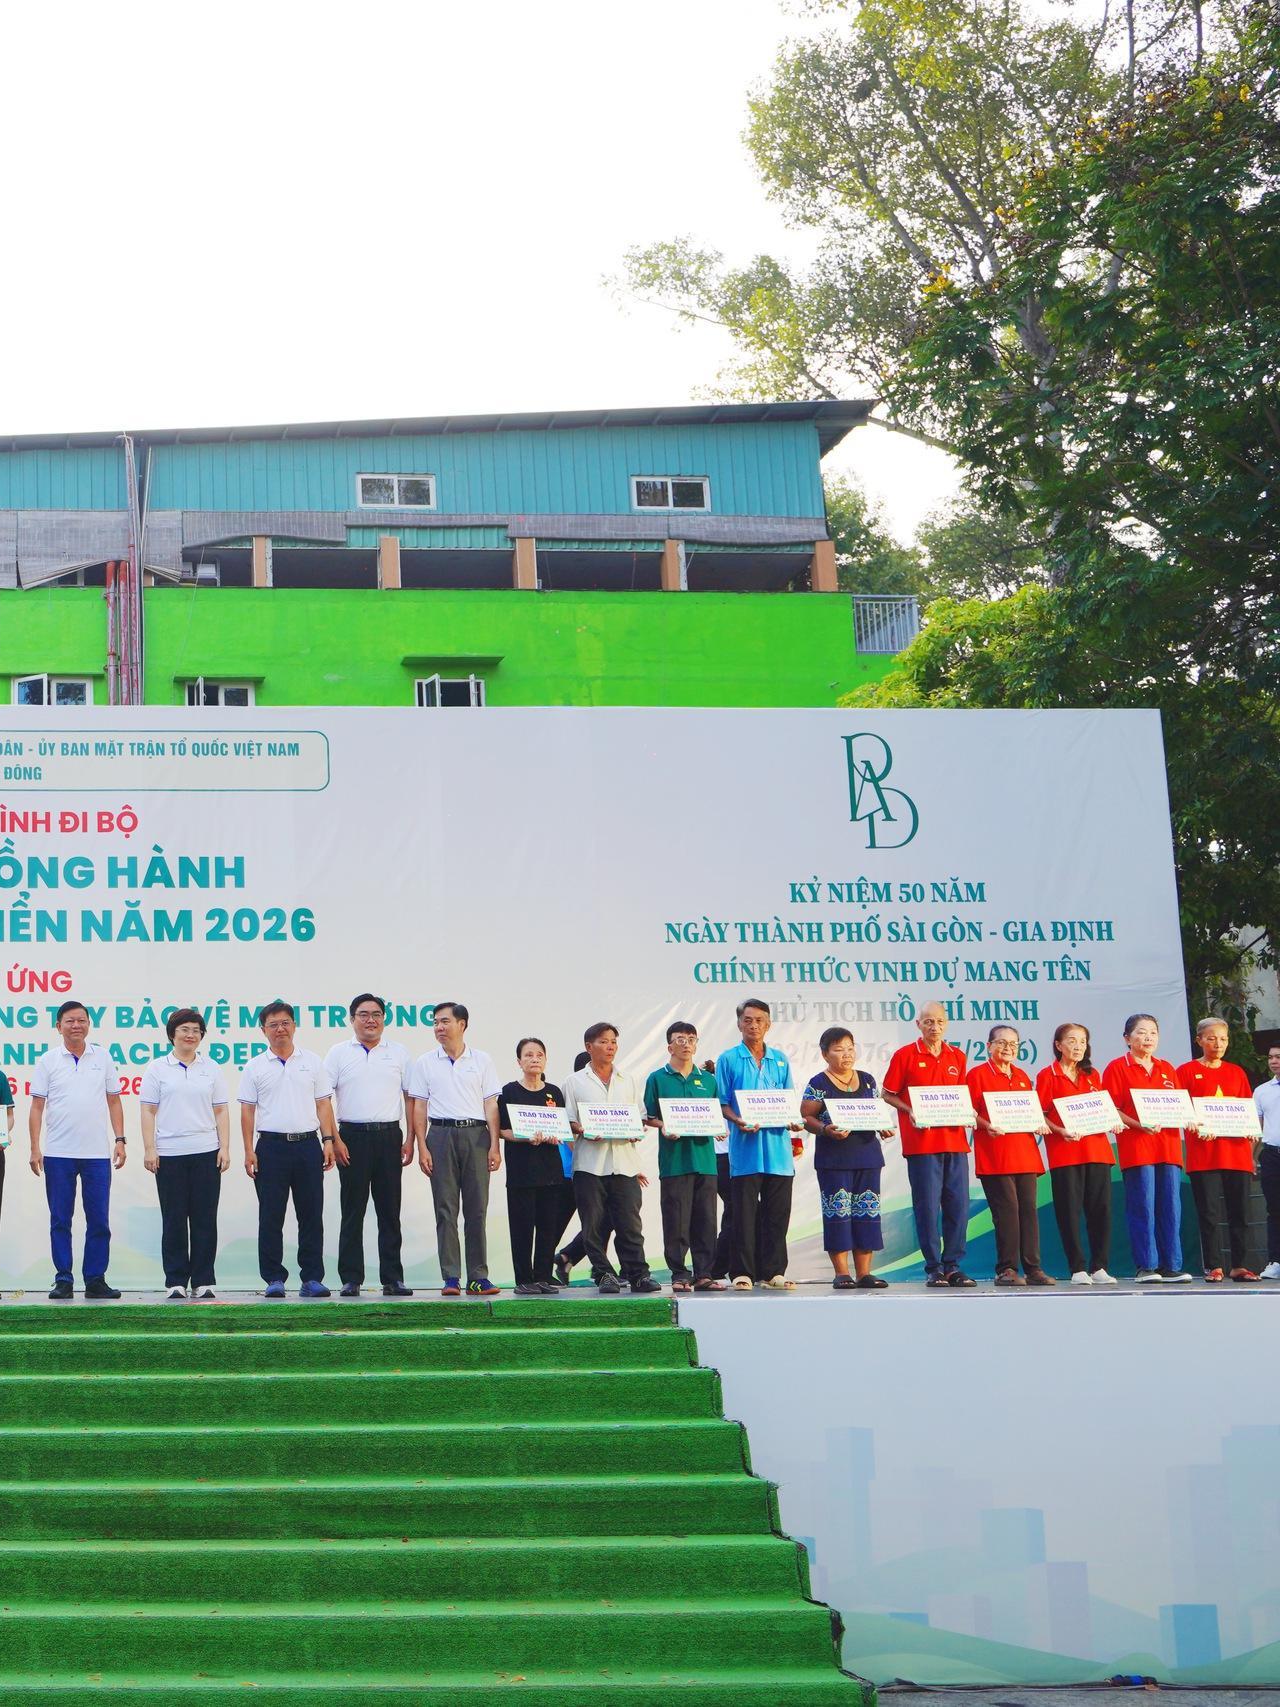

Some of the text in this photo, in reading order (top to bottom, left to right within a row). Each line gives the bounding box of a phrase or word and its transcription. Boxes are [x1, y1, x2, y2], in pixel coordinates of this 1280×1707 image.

[39, 738, 56, 757] ỦY
[61, 742, 89, 756] BAN
[95, 740, 124, 759] MẶT
[129, 740, 165, 759] TRẬN
[170, 738, 187, 757] TỔ
[192, 738, 228, 757] QUỐC
[233, 740, 262, 759] VIỆT
[268, 742, 299, 756] NAM
[4, 764, 42, 780] ĐÔNG
[60, 812, 88, 832] ĐI
[97, 805, 138, 838] BỘ
[106, 843, 246, 890] HÀNH
[789, 876, 987, 911] KỶ NIỆM 50 NĂM
[81, 898, 193, 943] NĂM
[204, 906, 316, 943] 2026
[665, 916, 727, 944] NGÀY
[733, 916, 824, 944] THÀNH
[829, 913, 883, 944] PHỐ
[885, 915, 926, 944] SÀI
[930, 915, 984, 944] GÒN
[1001, 921, 1046, 944] GIA
[1049, 919, 1116, 950] ĐỊNH
[7, 964, 72, 992] ỨNG
[693, 955, 1093, 991] CHÍNH THỨC VINH DỰ MANG TÊN
[46, 1006, 107, 1028] TY
[880, 993, 916, 1022] HỒ
[971, 1000, 1039, 1021] MINH
